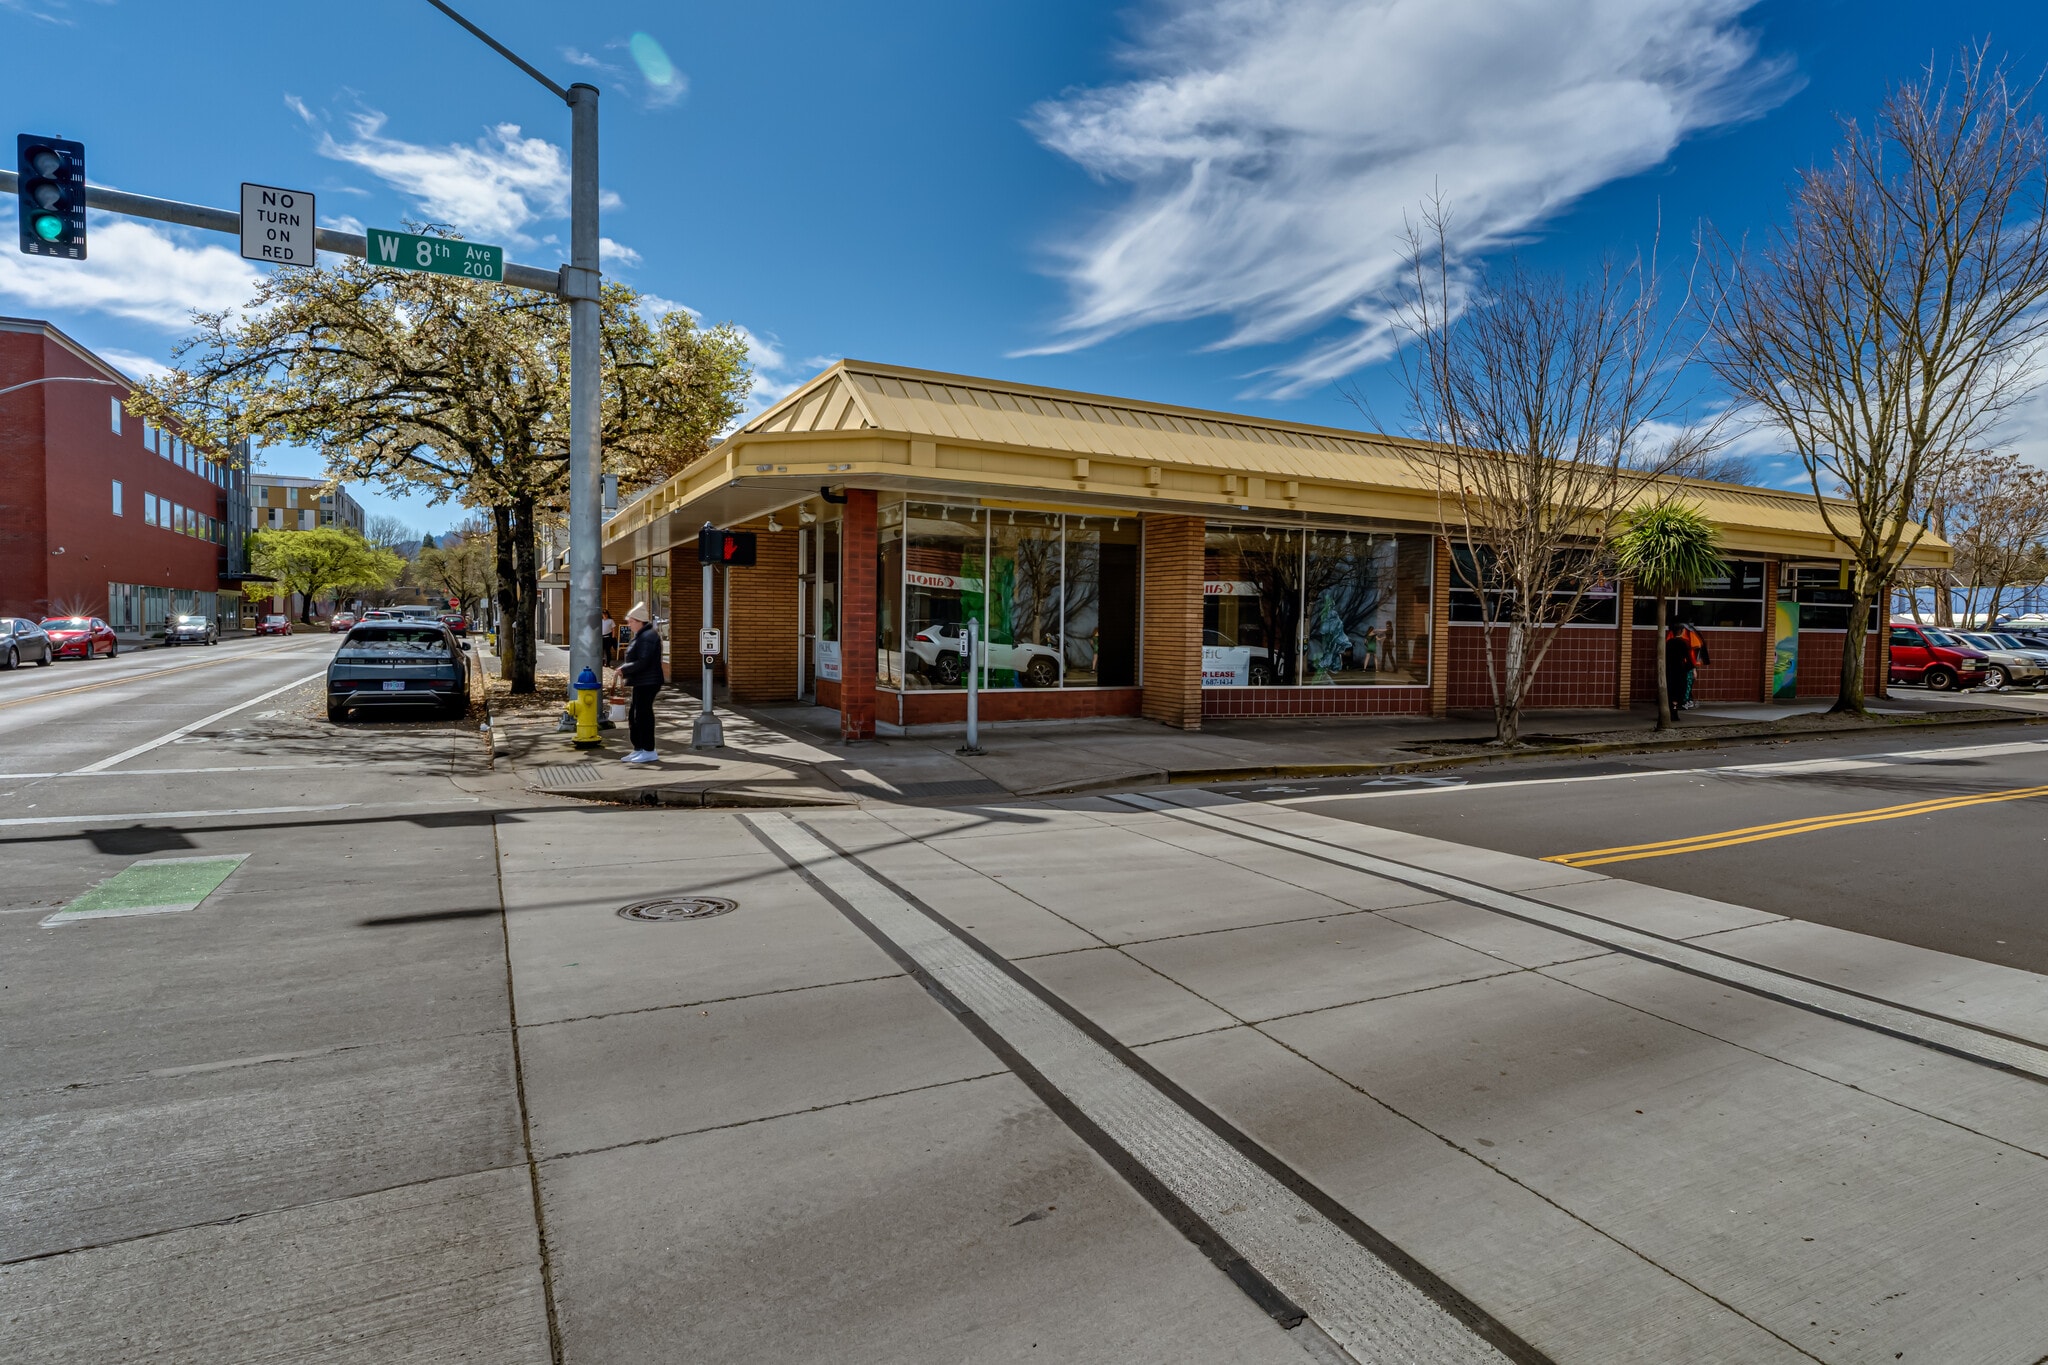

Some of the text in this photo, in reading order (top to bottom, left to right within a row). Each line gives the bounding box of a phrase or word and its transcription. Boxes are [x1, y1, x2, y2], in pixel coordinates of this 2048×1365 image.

[262, 191, 294, 209] NO
[257, 208, 300, 227] TURN
[266, 228, 290, 243] ON
[262, 245, 294, 260] RED
[378, 234, 491, 267] W 8th Ave
[463, 261, 493, 278] 200
